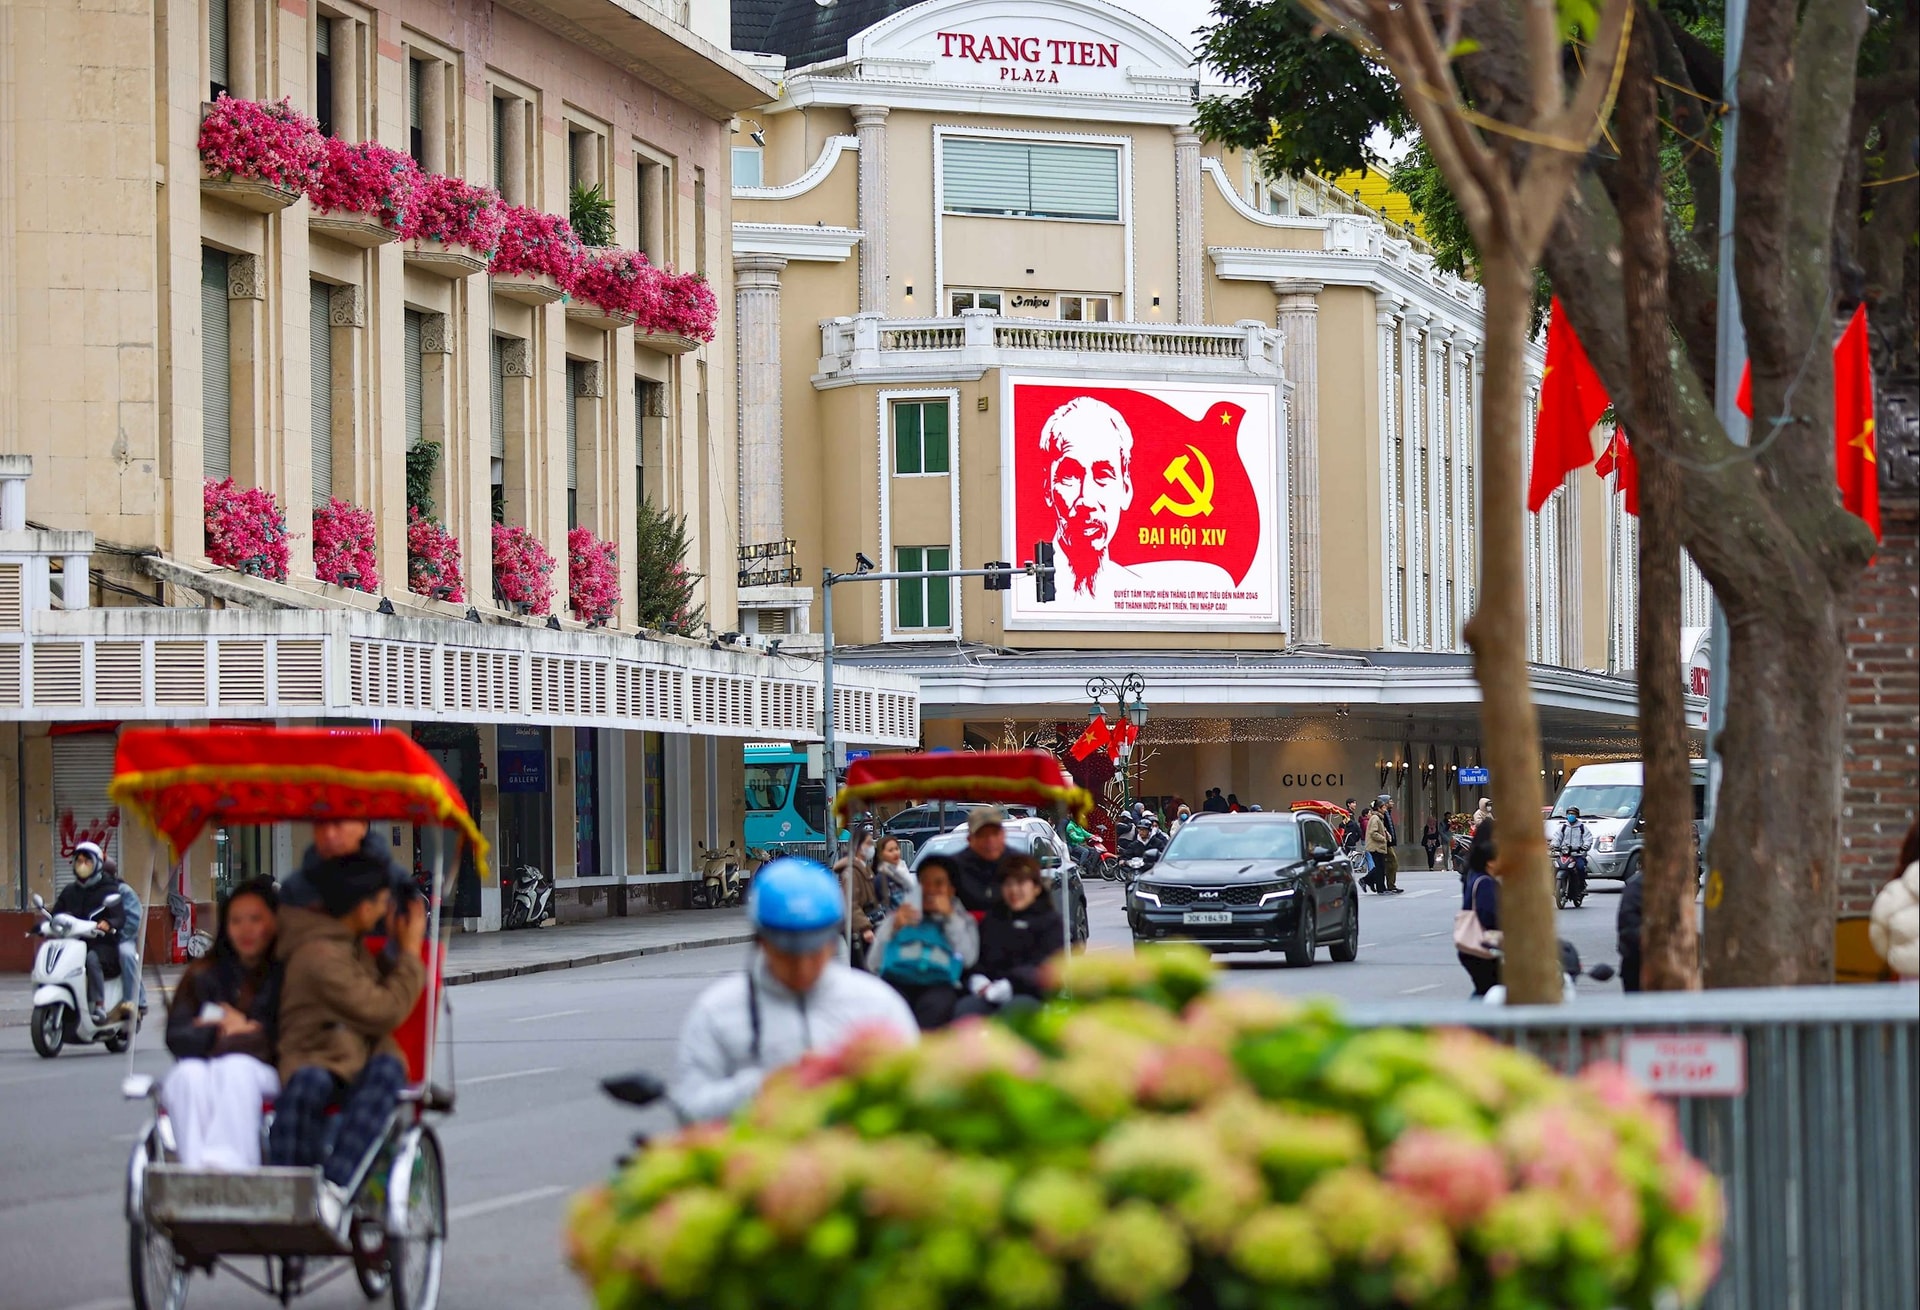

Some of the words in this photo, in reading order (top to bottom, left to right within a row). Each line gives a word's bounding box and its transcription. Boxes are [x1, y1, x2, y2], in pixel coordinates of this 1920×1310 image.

[937, 32, 1041, 63] TRANG
[1047, 40, 1119, 67] TIEN
[1000, 67, 1059, 83] PLAZA
[1023, 295, 1050, 309] mipa
[1138, 527, 1165, 549] ĐẠI
[1170, 524, 1197, 549] HỘI
[1201, 529, 1227, 546] XIV
[1282, 773, 1344, 787] GUCCI
